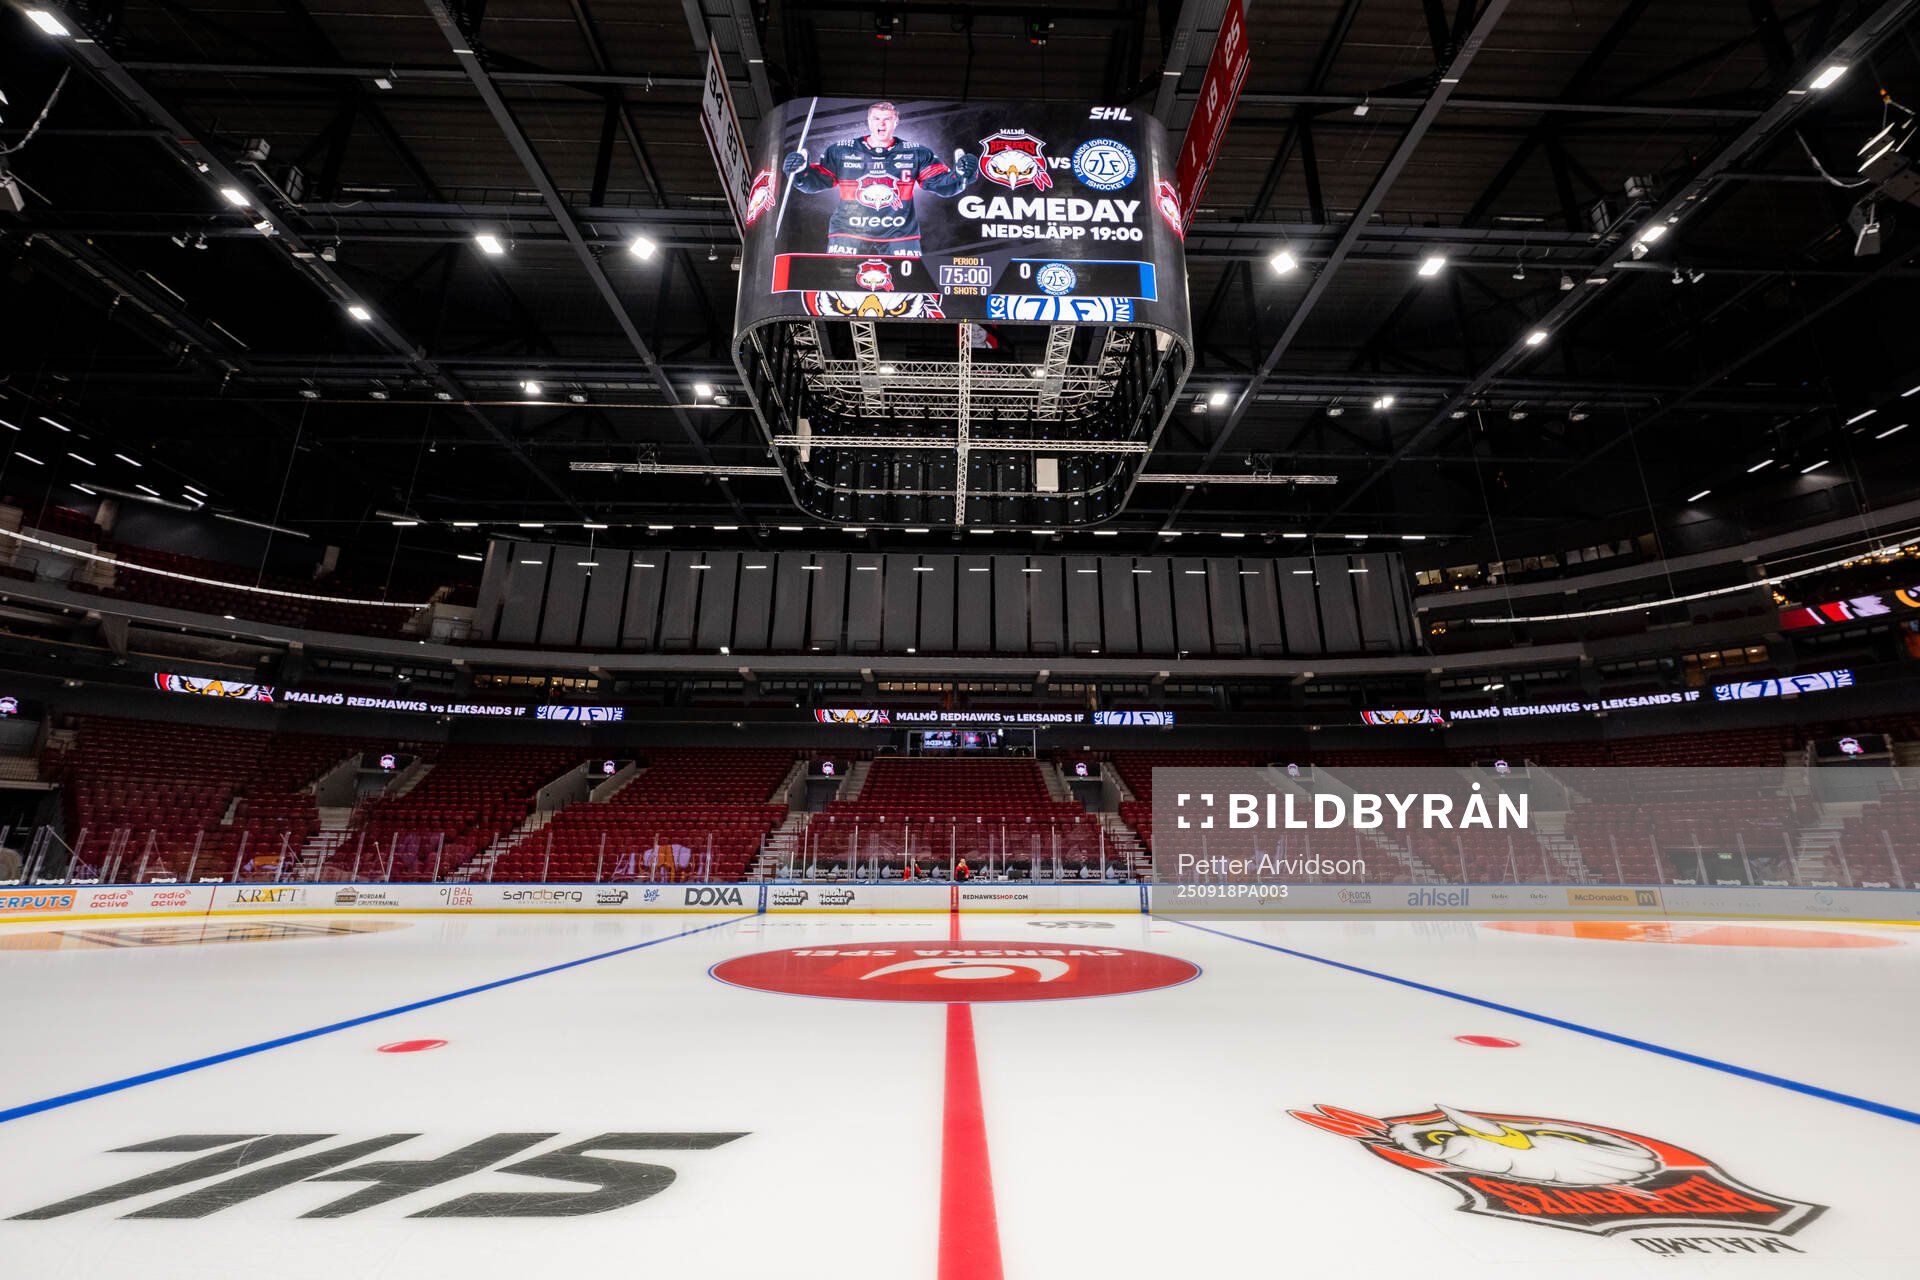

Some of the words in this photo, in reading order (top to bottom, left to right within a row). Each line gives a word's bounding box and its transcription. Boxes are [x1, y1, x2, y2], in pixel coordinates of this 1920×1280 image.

[1206, 77, 1218, 123] 18
[1089, 106, 1133, 122] SHL
[1000, 128, 1026, 136] MALMÖ
[1047, 156, 1072, 170] VS
[957, 196, 1141, 223] GAMEDAY
[849, 216, 906, 228] areco
[981, 222, 1086, 240] NEDSLÄPP
[1090, 227, 1143, 241] 19:00
[953, 257, 979, 266] PERIOD
[900, 260, 912, 277] 0
[1019, 262, 1031, 279] 0
[944, 268, 989, 284] 75:00
[944, 287, 951, 295] 0
[953, 287, 978, 295] SHOTS
[980, 287, 987, 296] 0
[284, 690, 344, 705] MALMÖ
[346, 696, 428, 712] REDHAWKS
[429, 704, 445, 713] vs
[446, 703, 513, 716] LEKSANDS
[513, 706, 526, 717] IF
[1450, 706, 1500, 720] MALMÖ
[1502, 702, 1580, 717] REDHAWKS
[1582, 702, 1599, 712] vs
[1602, 691, 1683, 710] LEKSANDS
[1684, 690, 1700, 702] IF
[896, 709, 938, 721] MALMÖ
[940, 712, 1001, 722] REDHAWKS
[1003, 714, 1015, 722] vs
[1017, 713, 1072, 723] LEKSANDS
[1074, 714, 1084, 723] IF
[93, 891, 128, 900] radio
[153, 890, 186, 899] radio
[235, 888, 301, 903] KRAFT
[453, 887, 473, 896] BAL
[502, 889, 583, 902] sandberg
[684, 887, 743, 906] DOXA
[1407, 888, 1469, 906] ahlsell
[1574, 893, 1630, 901] McDonald's
[90, 900, 129, 908] active
[151, 899, 188, 907] active
[451, 896, 473, 906] DER
[773, 896, 802, 904] HOCKEY
[819, 896, 849, 904] HOCKEY
[791, 949, 898, 957] SPEL
[914, 949, 1125, 957] SVENSKA
[1468, 1174, 1780, 1214] REDHAWKS
[1630, 1236, 1809, 1258] MALMÖ
